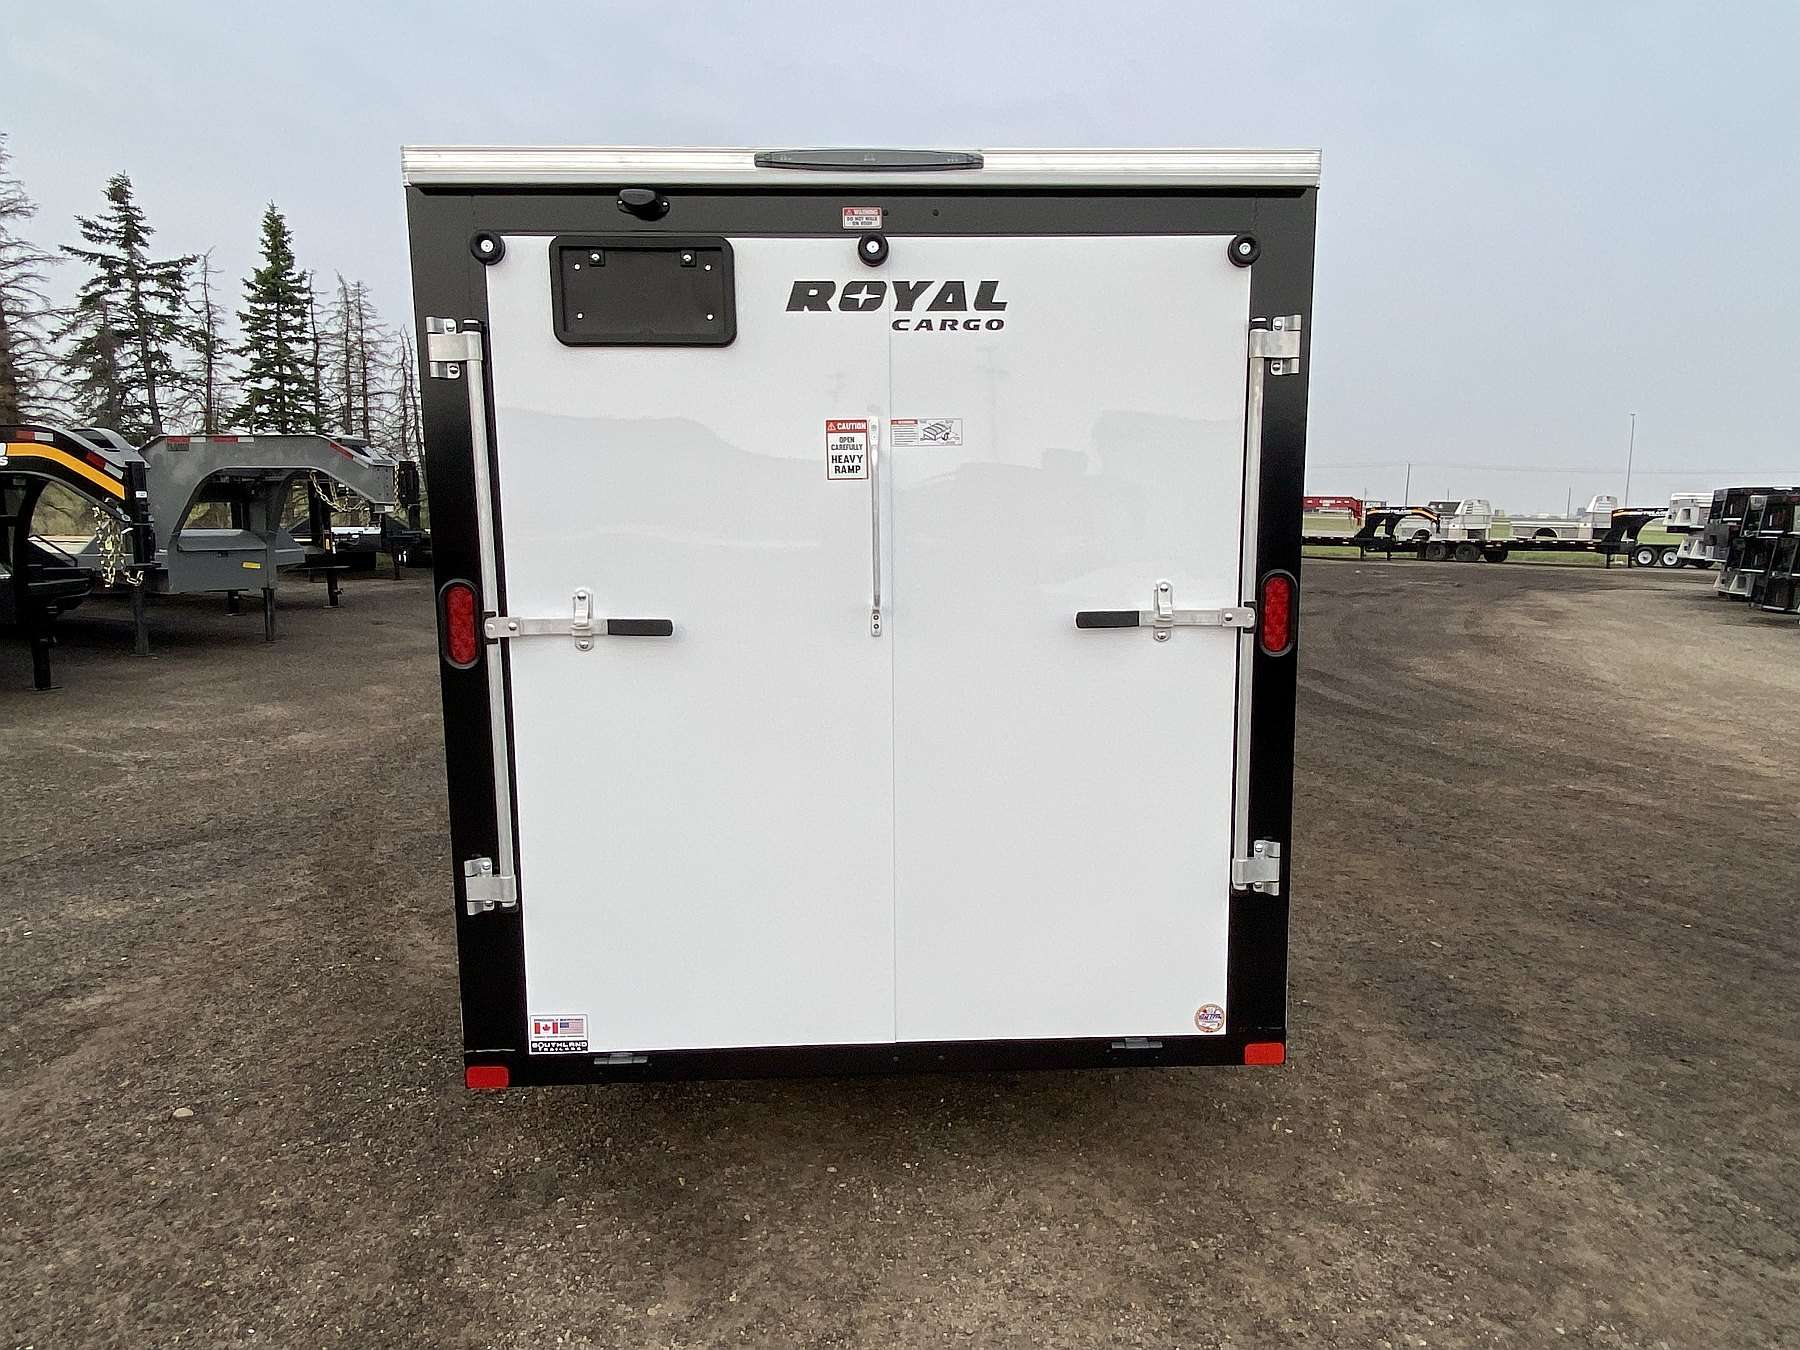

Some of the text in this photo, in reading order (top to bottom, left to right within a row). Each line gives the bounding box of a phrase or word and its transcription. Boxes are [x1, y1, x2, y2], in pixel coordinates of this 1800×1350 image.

[785, 280, 1008, 312] ROYAL
[891, 318, 1005, 331] CARGO
[837, 422, 866, 430] CAUTION
[831, 454, 864, 463] HEAVY
[834, 465, 861, 474] RAMP
